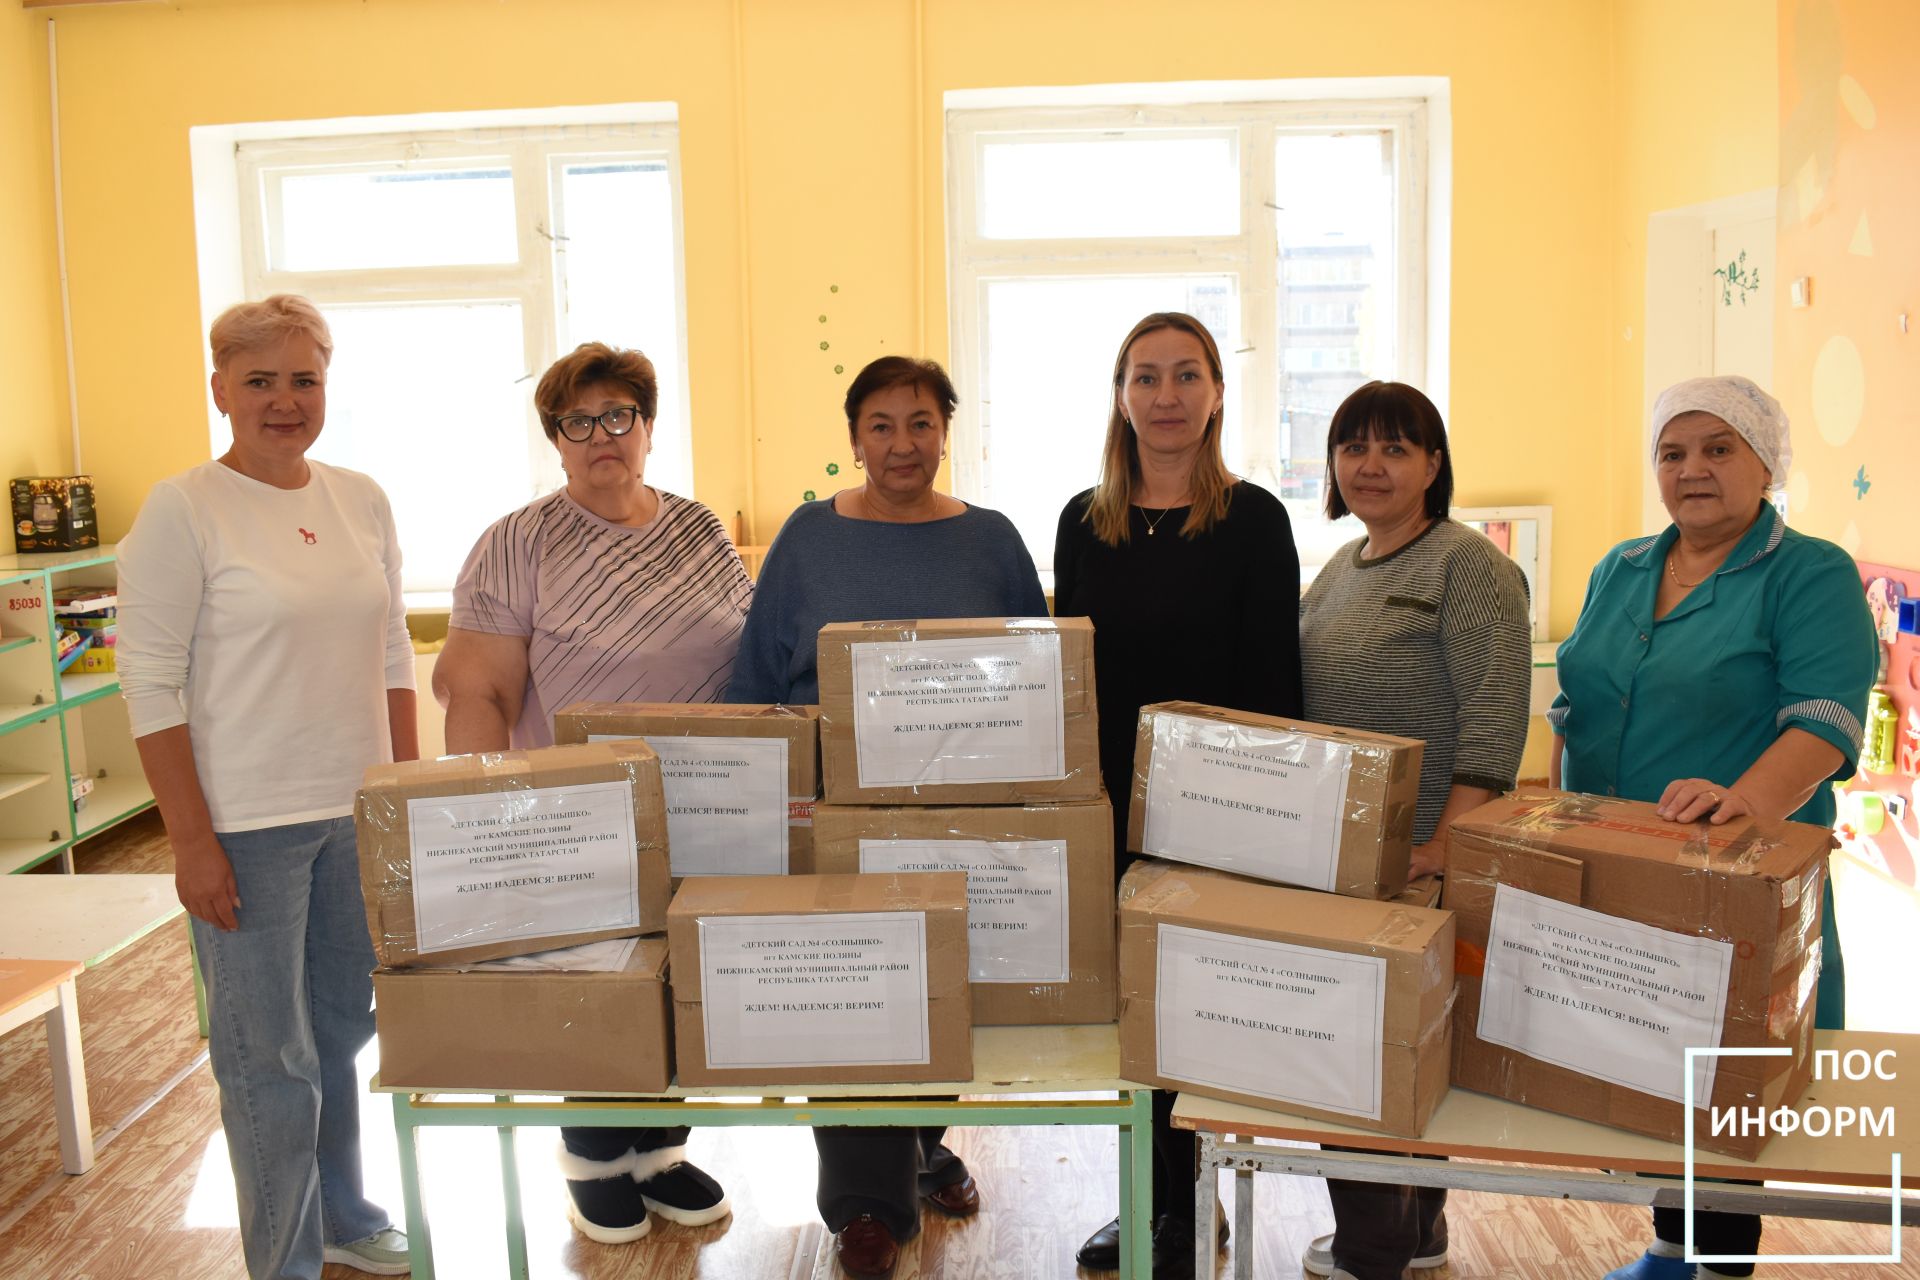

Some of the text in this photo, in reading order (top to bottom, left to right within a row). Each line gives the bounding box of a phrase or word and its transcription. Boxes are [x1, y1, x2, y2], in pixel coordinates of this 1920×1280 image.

[9, 597, 41, 611] 85030
[934, 662, 950, 671] САД
[867, 683, 1046, 698] НИЖНЕКАМСКИЙ МУНИЦИПАЛЬНЫЙ РАЙОН
[906, 695, 1010, 706] РЕСПУБЛИКА ТАТАРСТАН
[893, 719, 1023, 733] ЖДЕМ! НАДЕЕМСЯ! ВЕРИМ!
[1225, 747, 1240, 758] САД
[664, 759, 679, 767] САД
[1215, 759, 1252, 772] КАМСКИЕ
[1254, 766, 1288, 779] ПОЛЯНЫ
[666, 807, 749, 815] АДЕЕМСЯ! ВЕРИМ!
[1180, 790, 1301, 821] ЖДЕМ! НАДЕЕМСЯ! ВЕРИМ!
[451, 818, 496, 830] «ДЕТСКИЙ
[488, 829, 532, 840] КАМСКИЕ
[533, 825, 572, 836] ПОЛЯНЫ
[426, 832, 618, 858] НИЖНЕКАМСКИЙ МУНИЦИПАЛЬНЫЙ РАЙОН
[469, 847, 579, 865] РЕСПУБЛИКА ТАТАРСТАН
[897, 861, 939, 871] «ДЕТСКИЙ
[940, 862, 957, 871] САД
[456, 871, 595, 894] ЖДЕМ! НАДЕЕМСЯ! ВЕРИМ!
[1025, 888, 1052, 896] РАЙОН
[992, 922, 1028, 930] ВЕРИМ!
[1532, 921, 1577, 941] «ДЕТСКИЙ
[1578, 934, 1598, 949] САД
[741, 938, 884, 949] «ДЕТСКИЙ САД №4 «СОЛНЫШКО»
[778, 953, 821, 961] КАМСКИЕ
[823, 952, 862, 960] ПОЛЯНЫ
[1566, 944, 1612, 965] КАМСКИЕ
[1613, 956, 1656, 975] ПОЛЯНЫ
[716, 963, 909, 975] НИЖНЕКАМСКИЙ МУНИЦИПАЛЬНЫЙ РАЙОН
[1194, 955, 1341, 985] «ДЕТСКИЙ САД № 4 «СОЛНЫШКО»
[1503, 939, 1706, 1003] НИЖНЕКАМСКИЙ МУНИЦИПАЛЬНЫЙ РАЙОН
[758, 975, 869, 985] РЕСПУБЛИКА ТАТАРСТАН
[1230, 975, 1274, 990] КАМСКИЕ
[1275, 981, 1316, 996] ПОЛЯНЫ
[1542, 962, 1659, 1002] РЕСПУБЛИКА ТАТАРСТАН
[745, 1001, 884, 1013] ЖДЕМ! НАДЕЕМСЯ! ВЕРИМ!
[1523, 984, 1670, 1035] ЖДЕМ! НАДЕЕМСЯ! ВЕРИМ!
[1194, 1009, 1335, 1042] ЖДЕМ! НАДЕЕМСЯ! ВЕРИМ!
